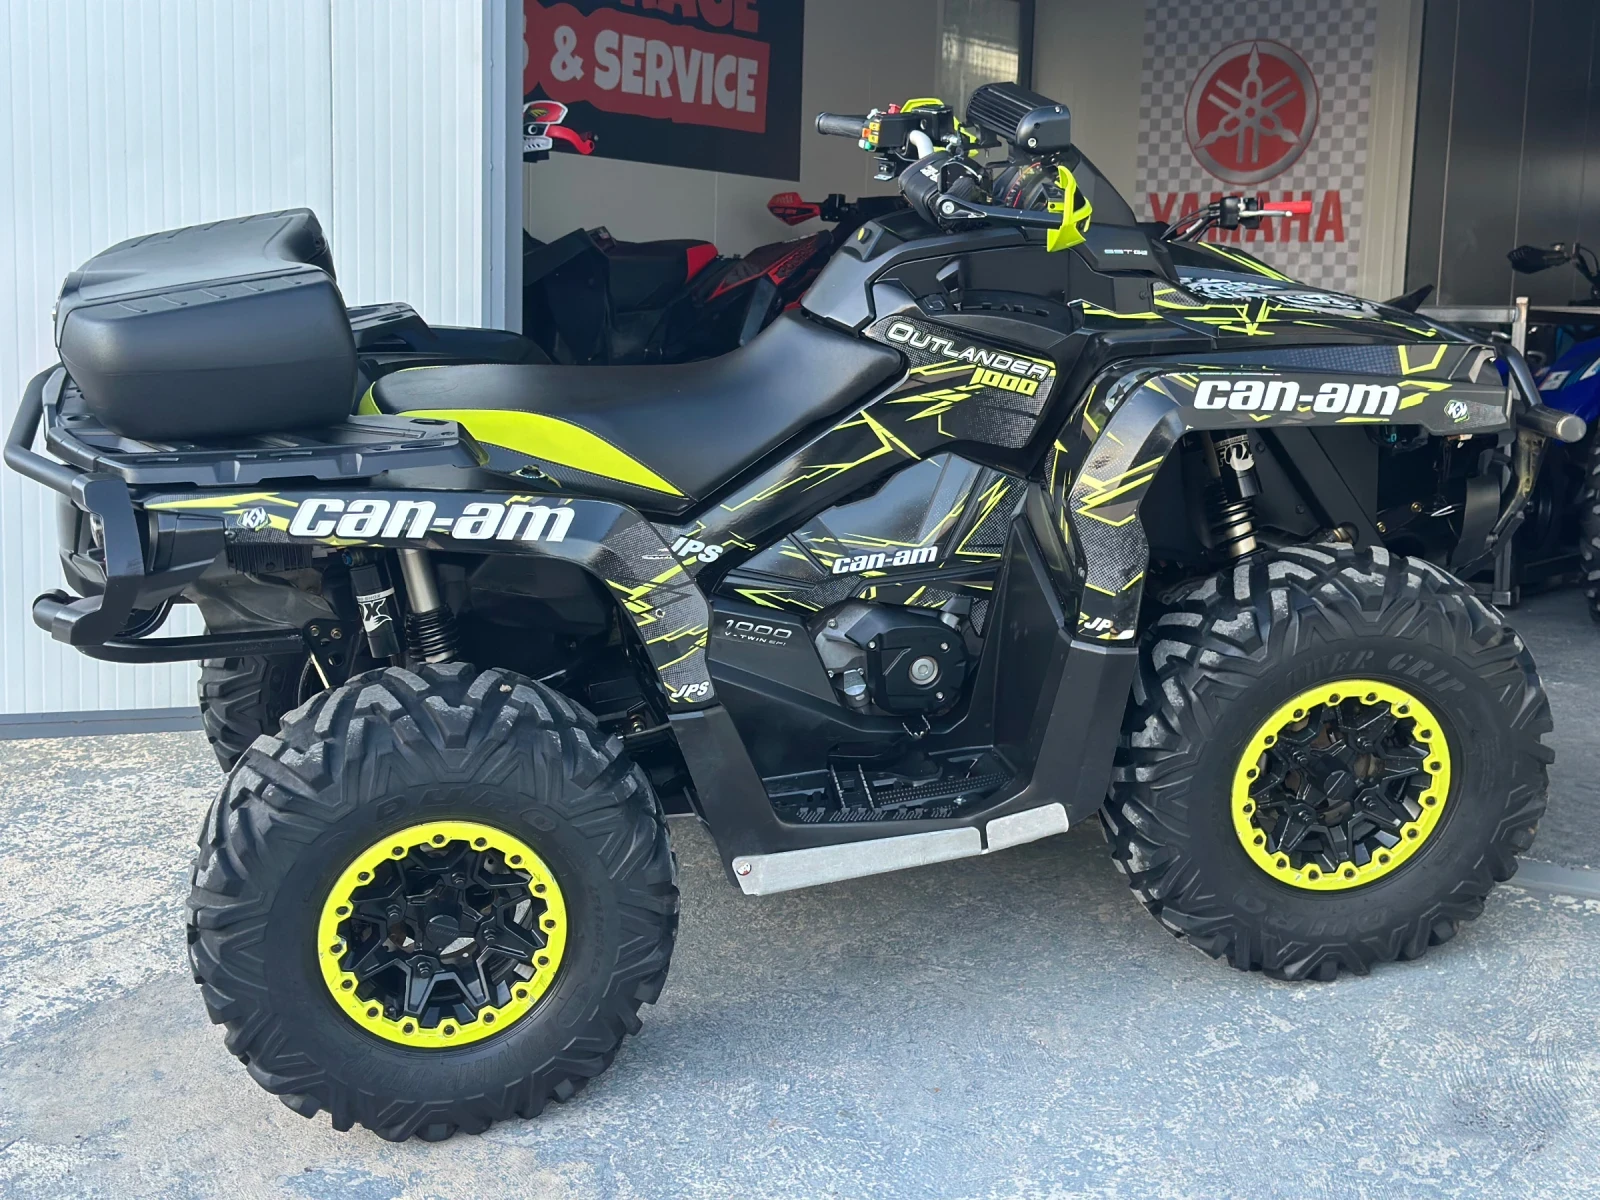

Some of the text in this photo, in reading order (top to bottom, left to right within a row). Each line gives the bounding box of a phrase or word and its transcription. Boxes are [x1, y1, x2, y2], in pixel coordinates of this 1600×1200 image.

[550, 25, 584, 82] &
[594, 29, 758, 113] SERVICE
[886, 321, 1049, 381] OUTLANDER
[969, 366, 1039, 397] 1000
[1193, 379, 1402, 417] can-am
[289, 498, 576, 542] can-am
[832, 546, 938, 575] can-am
[726, 619, 793, 639] 1000
[670, 681, 710, 698] JPS
